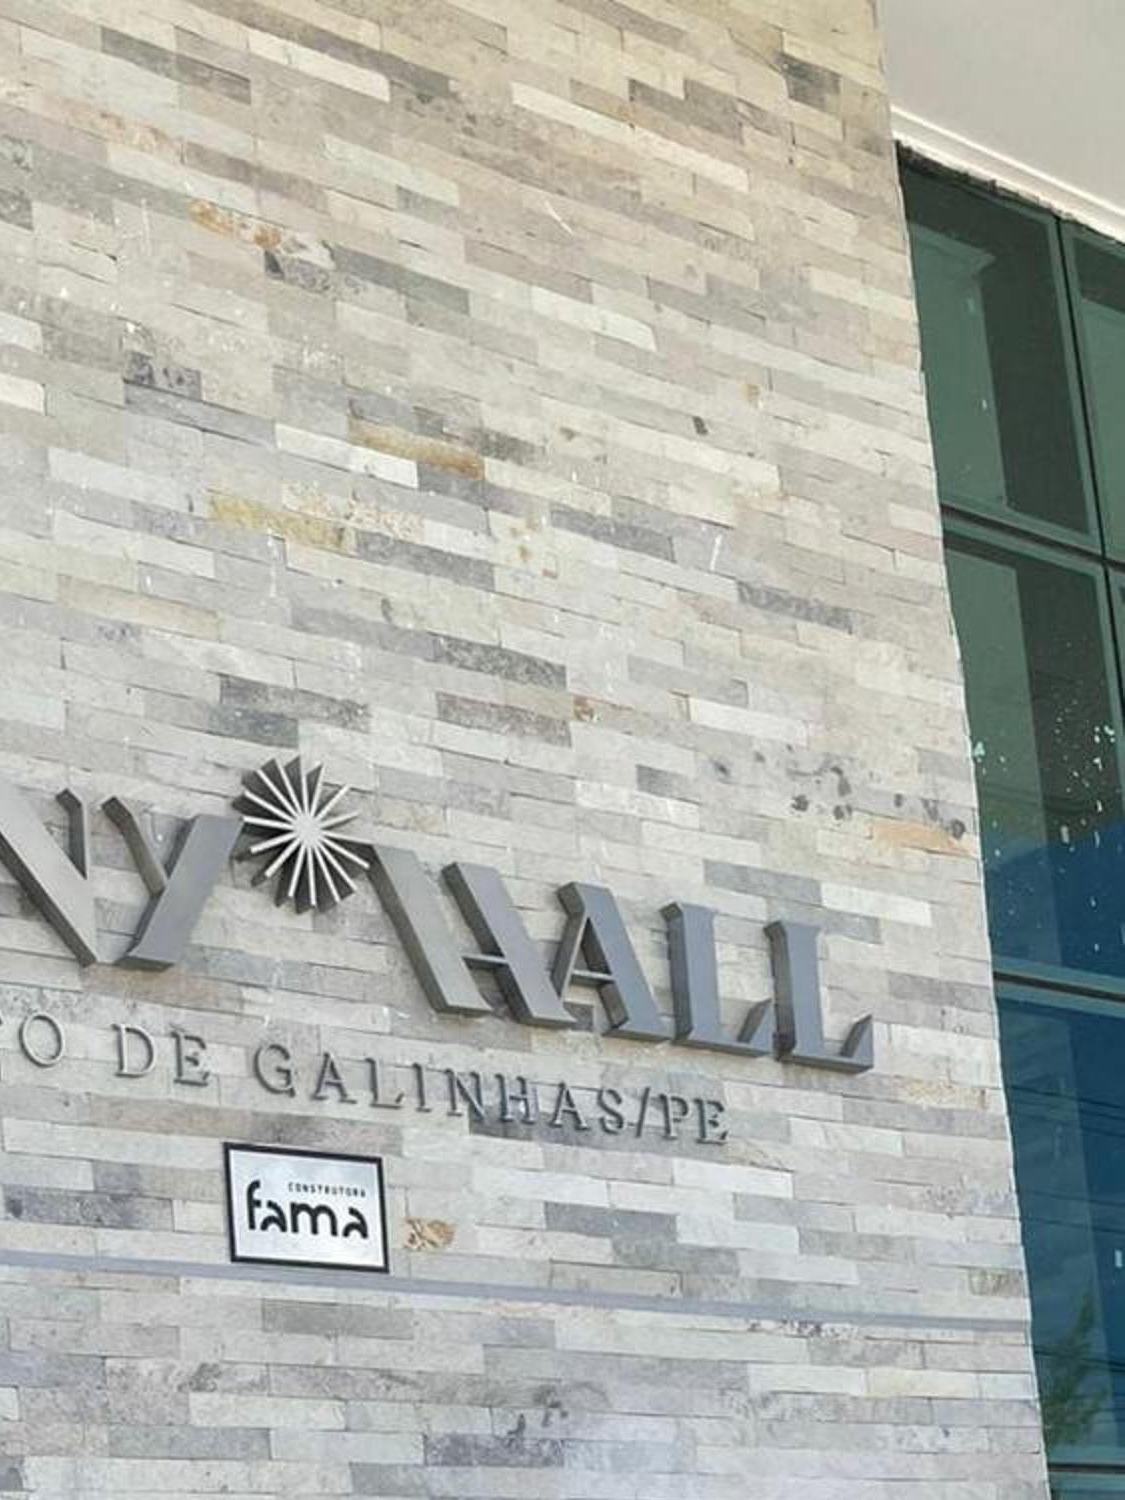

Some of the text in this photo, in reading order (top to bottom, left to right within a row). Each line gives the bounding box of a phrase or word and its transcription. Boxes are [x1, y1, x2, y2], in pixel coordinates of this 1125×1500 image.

[111, 1022, 211, 1087] DE
[252, 1041, 730, 1146] GALINHAS/PE
[246, 1179, 369, 1240] fama
[287, 1181, 367, 1199] CONSTRUTORA
